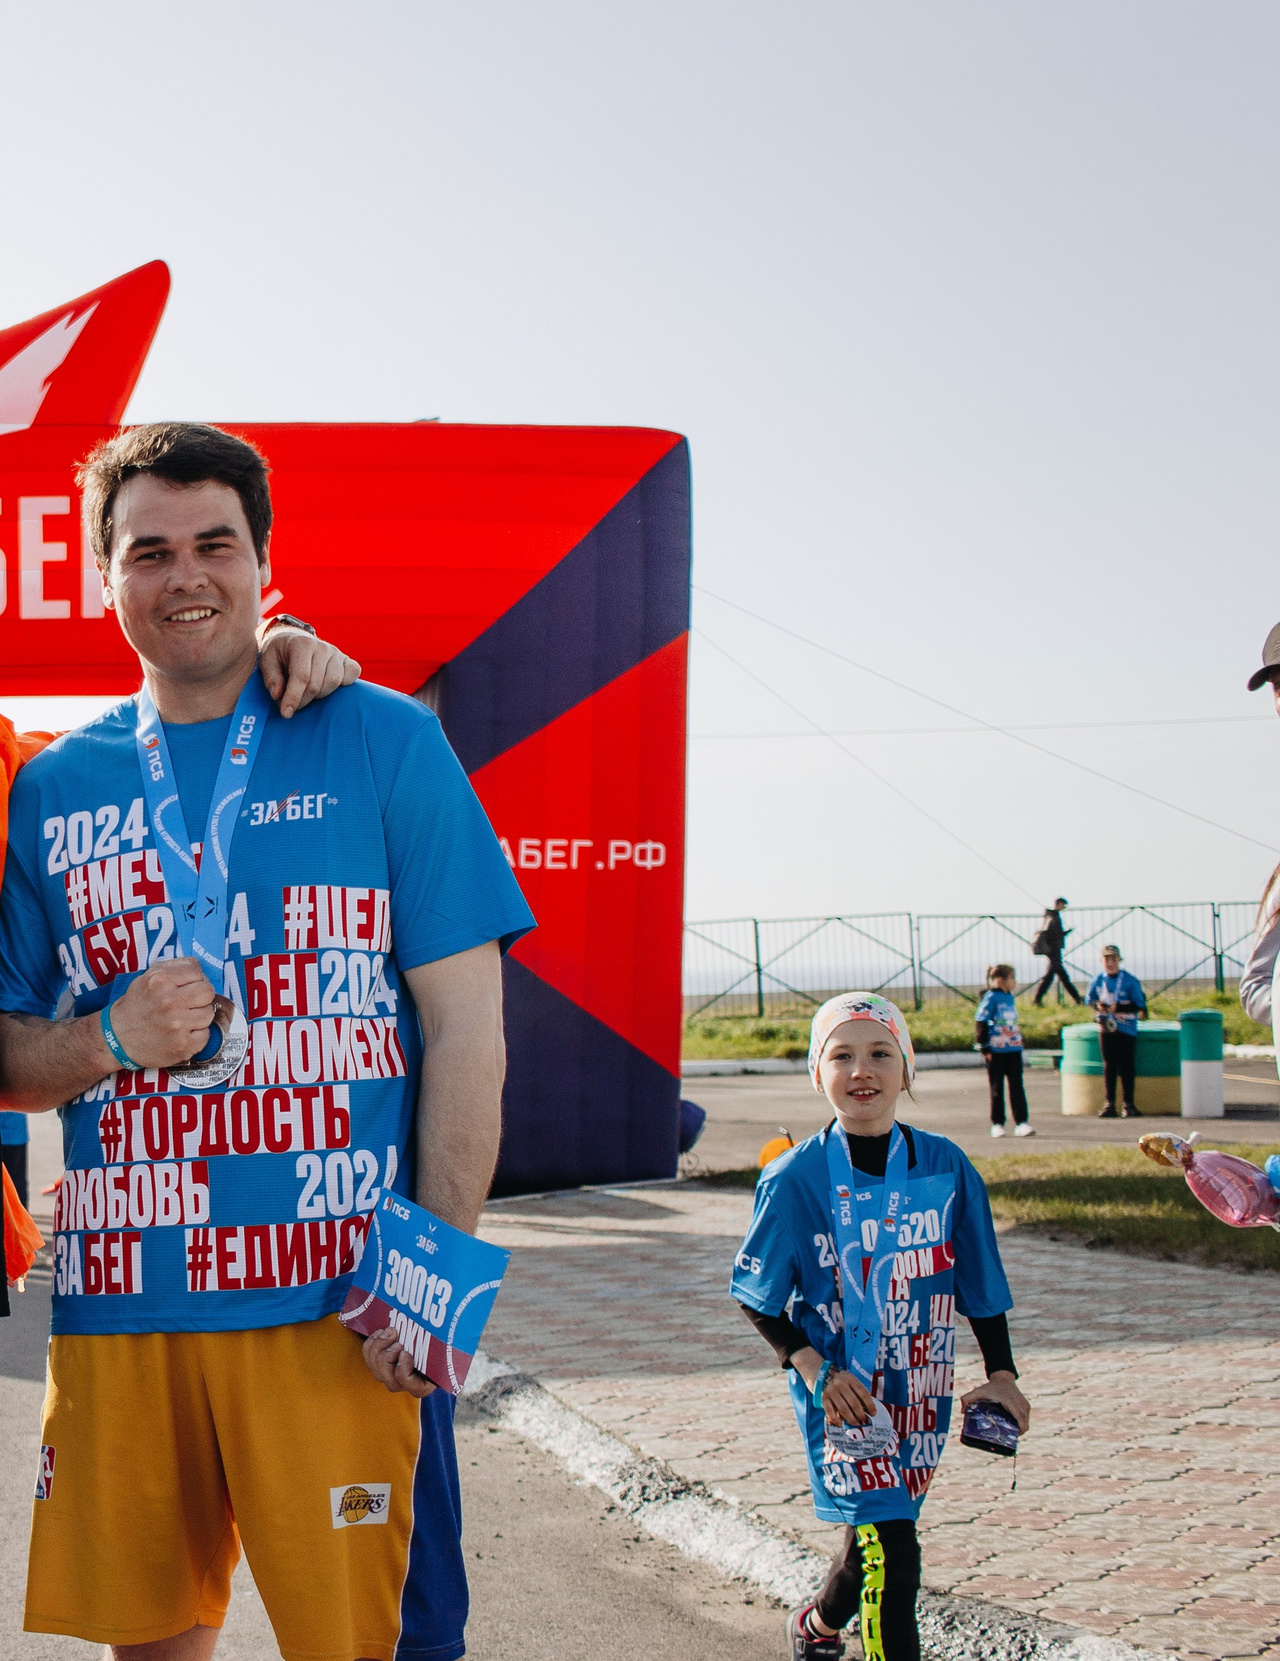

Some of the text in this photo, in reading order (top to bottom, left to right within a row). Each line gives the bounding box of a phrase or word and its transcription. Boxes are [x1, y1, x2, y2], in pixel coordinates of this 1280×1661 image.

[234, 714, 257, 746] ПСБ
[147, 749, 165, 782] ПСБ
[43, 797, 149, 876] 2024
[499, 836, 667, 871] АБЕГ.РФ
[66, 844, 172, 930] #МЕЧ
[283, 884, 393, 953] #ЦЕЛ
[320, 950, 399, 1018] 2024
[99, 1084, 351, 1164] #ГОРДОСТЬ
[391, 1203, 411, 1221] ПСБ
[839, 1200, 852, 1226] ПСБ
[888, 1191, 900, 1217] ПСБ
[384, 1248, 453, 1309] 30013
[882, 1300, 920, 1337] 024
[336, 1496, 387, 1517] LAKERS
